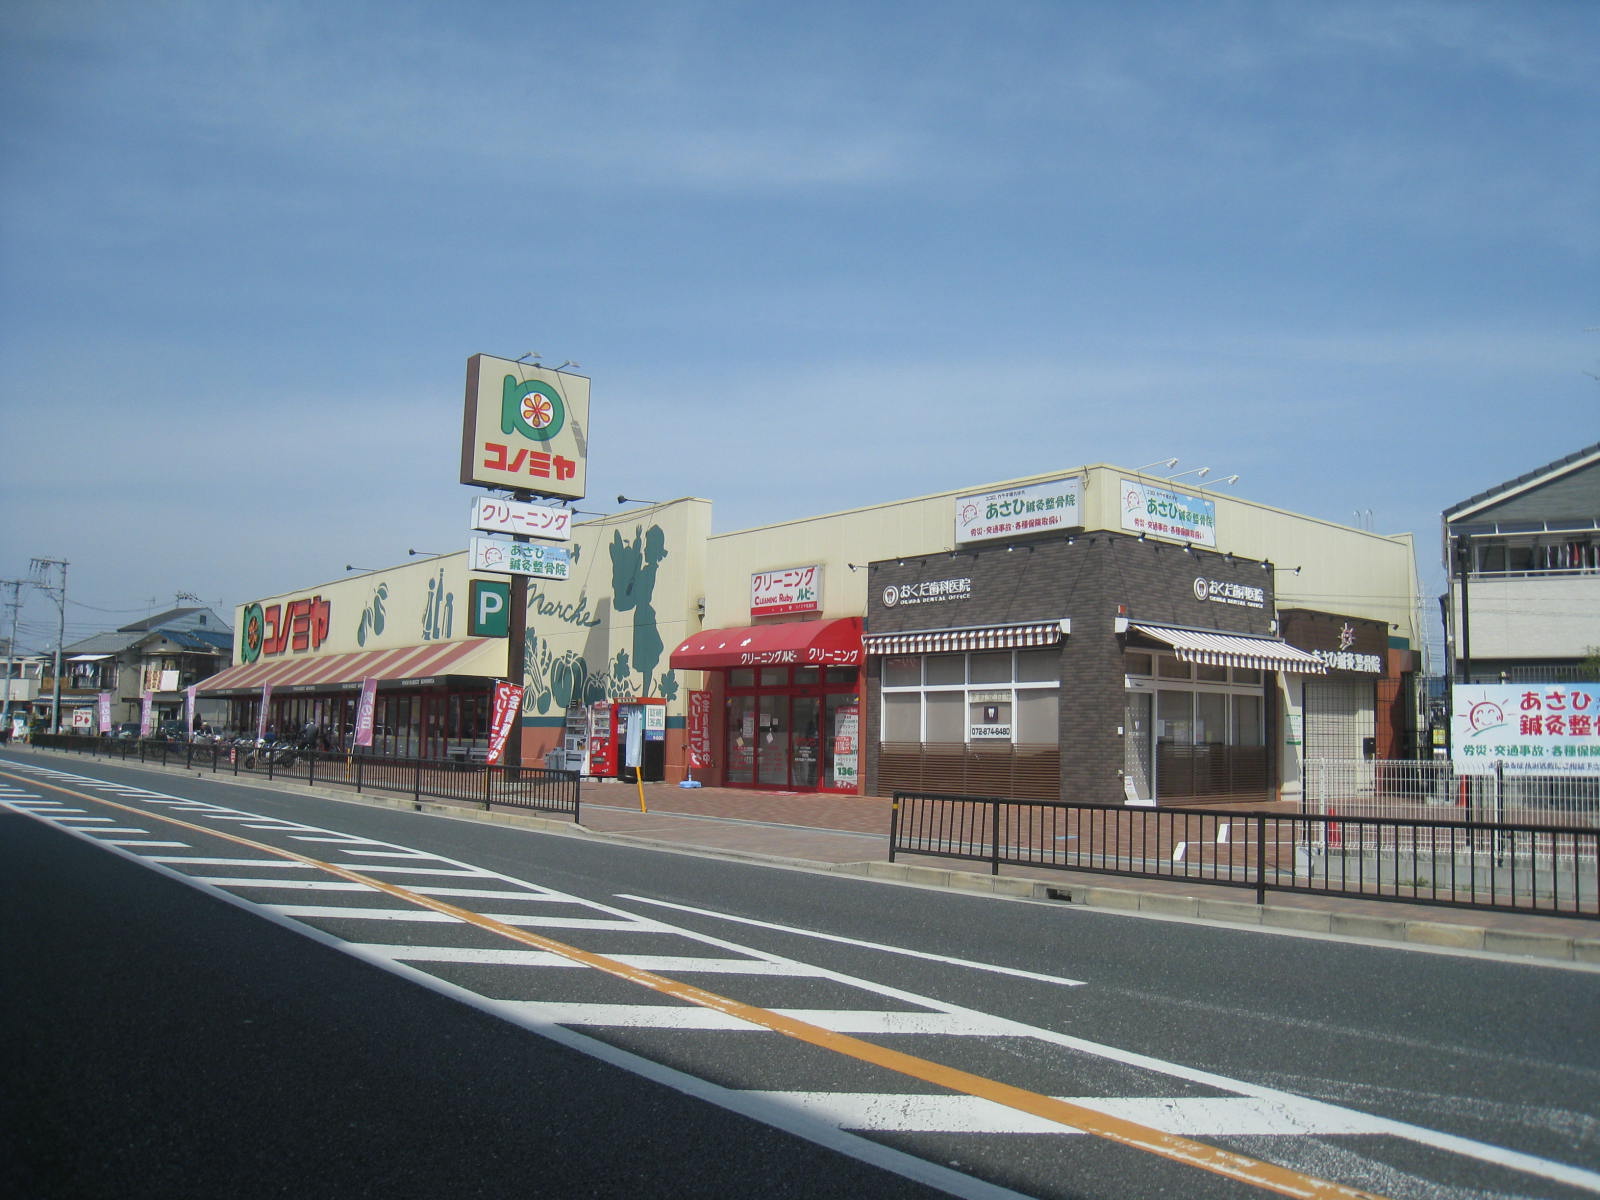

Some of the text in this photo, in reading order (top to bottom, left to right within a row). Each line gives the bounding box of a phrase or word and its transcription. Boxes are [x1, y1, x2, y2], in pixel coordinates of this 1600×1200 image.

[484, 442, 576, 480] コノミヤ
[482, 504, 569, 530] クリーニング
[510, 544, 545, 559] あさひ
[509, 557, 567, 576] 鍼灸整骨院
[753, 567, 815, 592] クリーニング
[900, 578, 971, 598] おくだ歯科医院
[779, 593, 793, 603] Ruby
[797, 587, 815, 601] ルビー
[922, 595, 946, 603] DENTAL
[1208, 580, 1264, 602] おくだ歯科医院
[480, 591, 504, 625] P
[263, 595, 331, 655] コノミヤ
[741, 650, 798, 665] クリーニングルビー
[808, 647, 858, 662] クリーニング
[1519, 691, 1592, 711] あさひ
[74, 715, 83, 725] P
